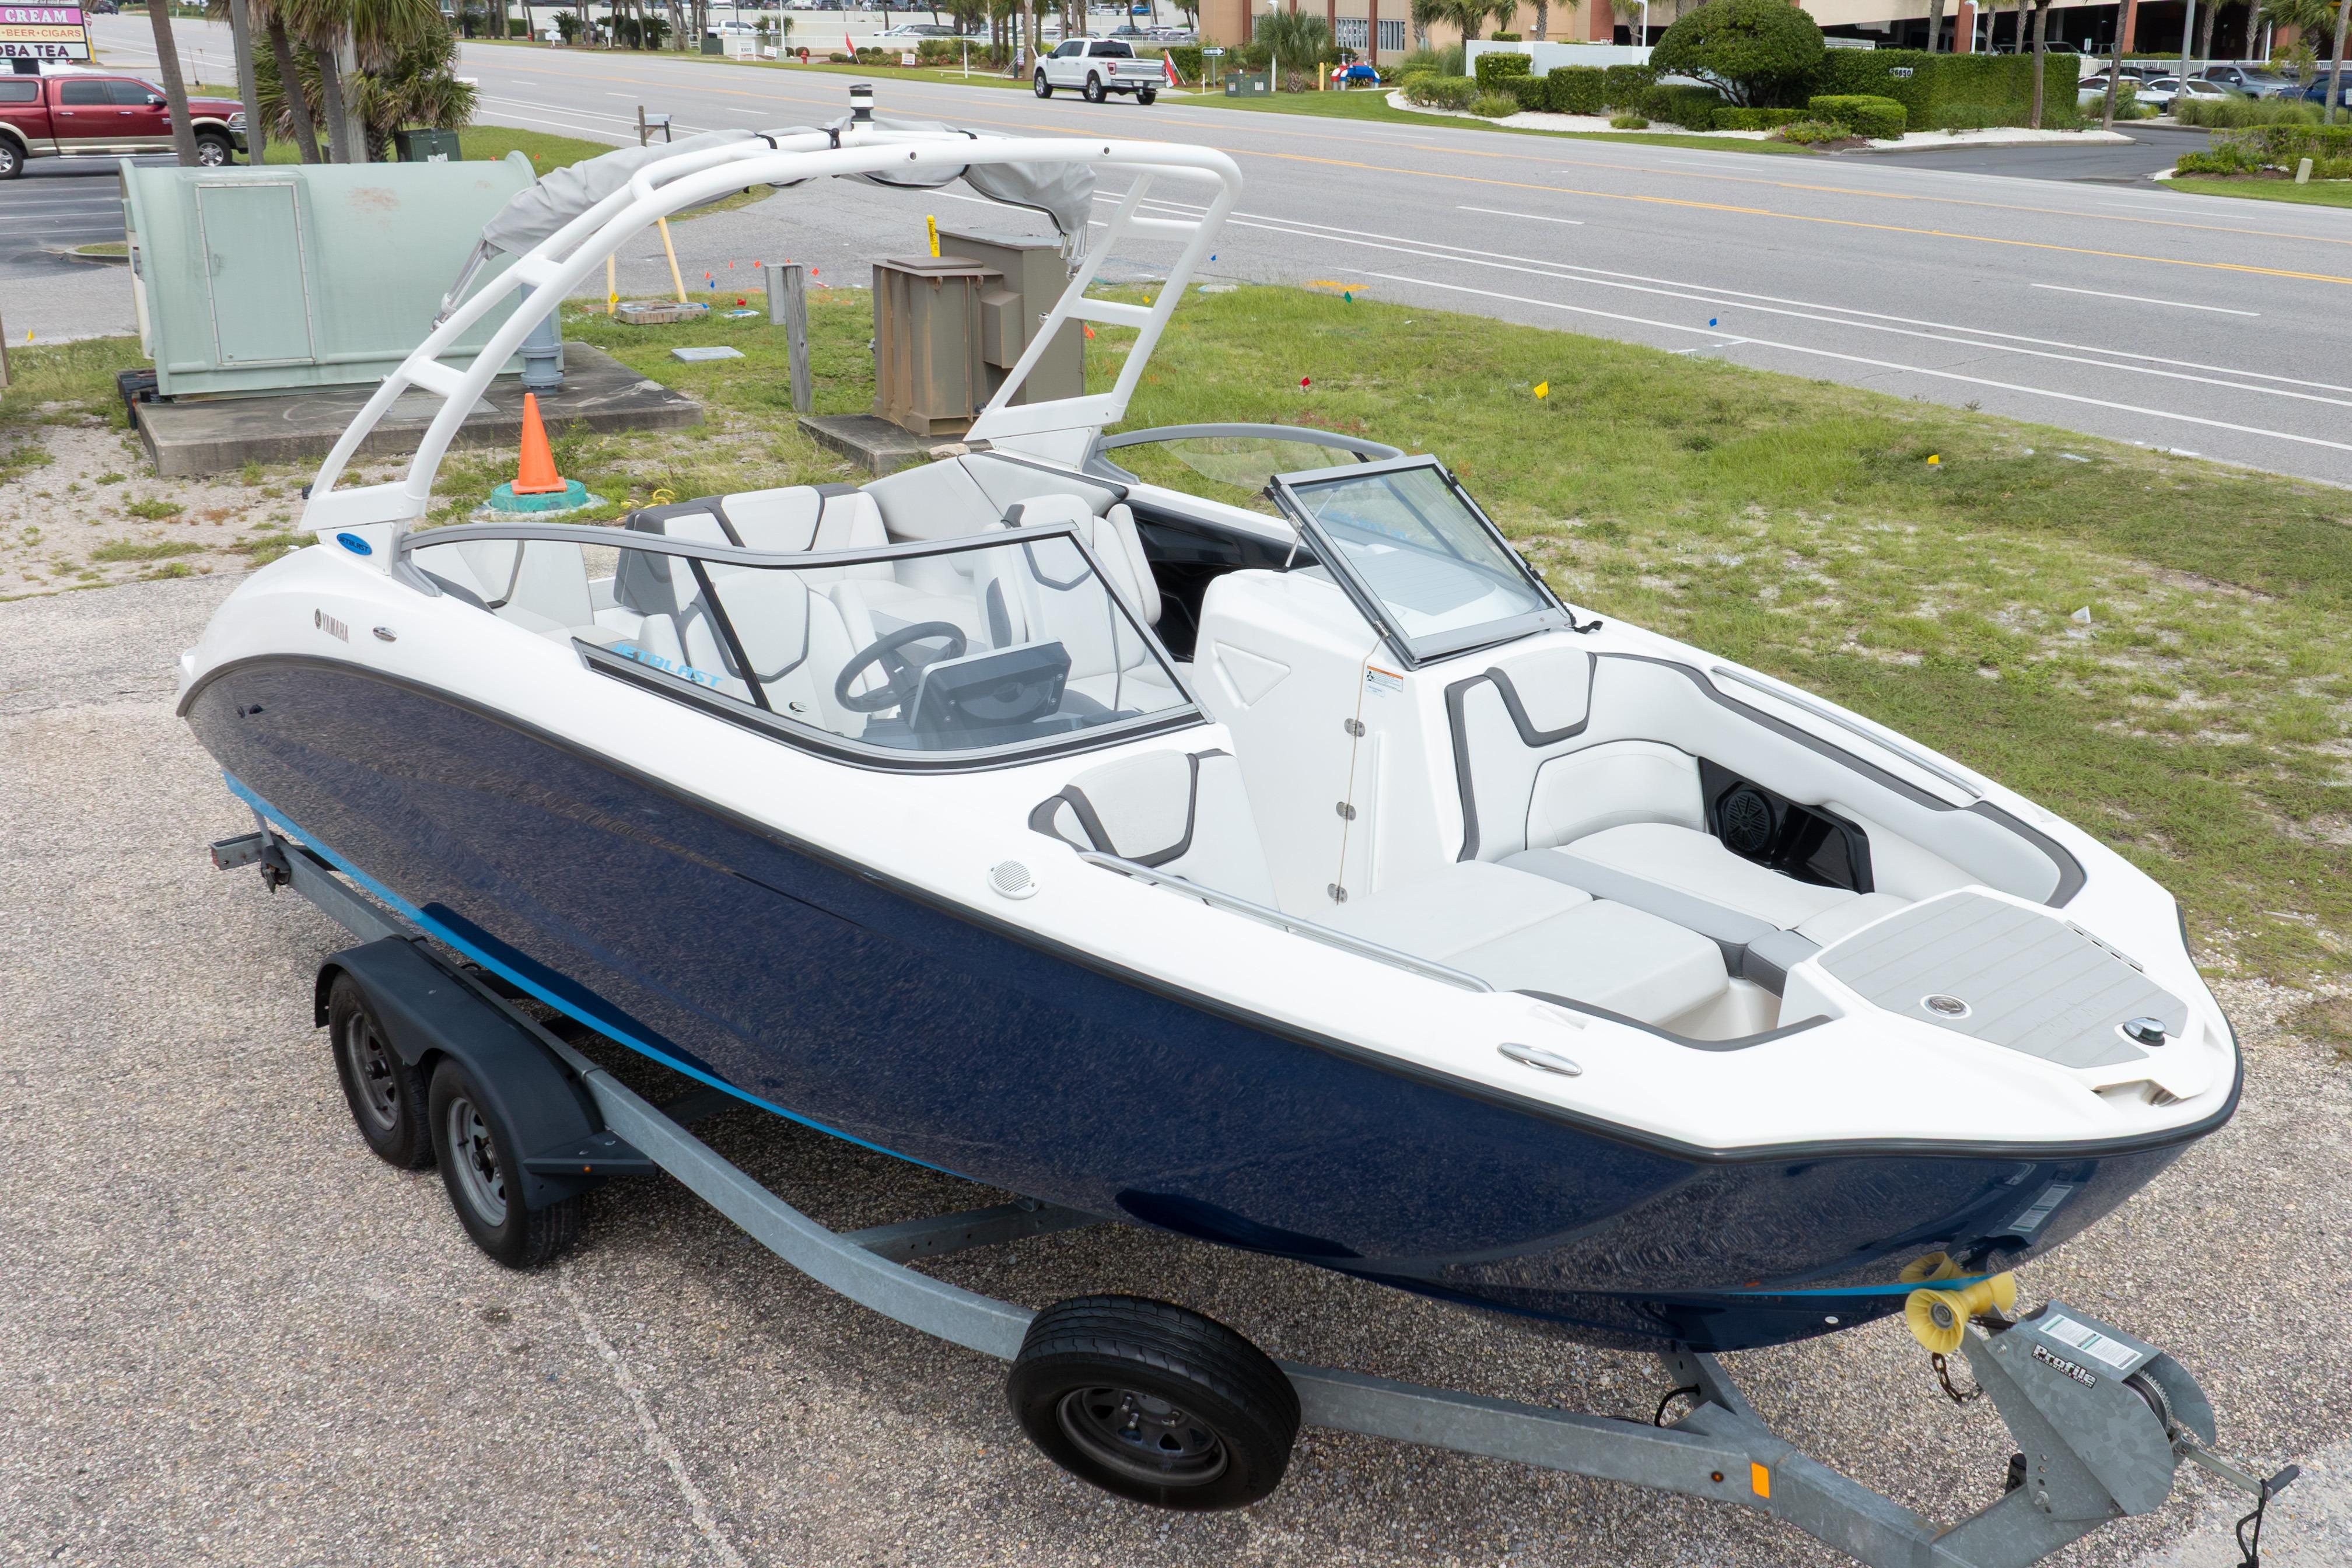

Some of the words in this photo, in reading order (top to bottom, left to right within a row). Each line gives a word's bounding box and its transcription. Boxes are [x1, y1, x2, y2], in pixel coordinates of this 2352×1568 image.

[5, 9, 69, 23] CREAM
[6, 29, 36, 37] BEER
[41, 29, 82, 37] CIGARS
[34, 45, 69, 57] TEA
[338, 537, 369, 552] JETBLAST
[322, 612, 349, 643] YAMAHA
[612, 643, 723, 687] JETBLAST
[2032, 1353, 2072, 1377] PERFORMANCE
[2073, 1376, 2092, 1388] WINCH
[2034, 1344, 2096, 1385] Profile
